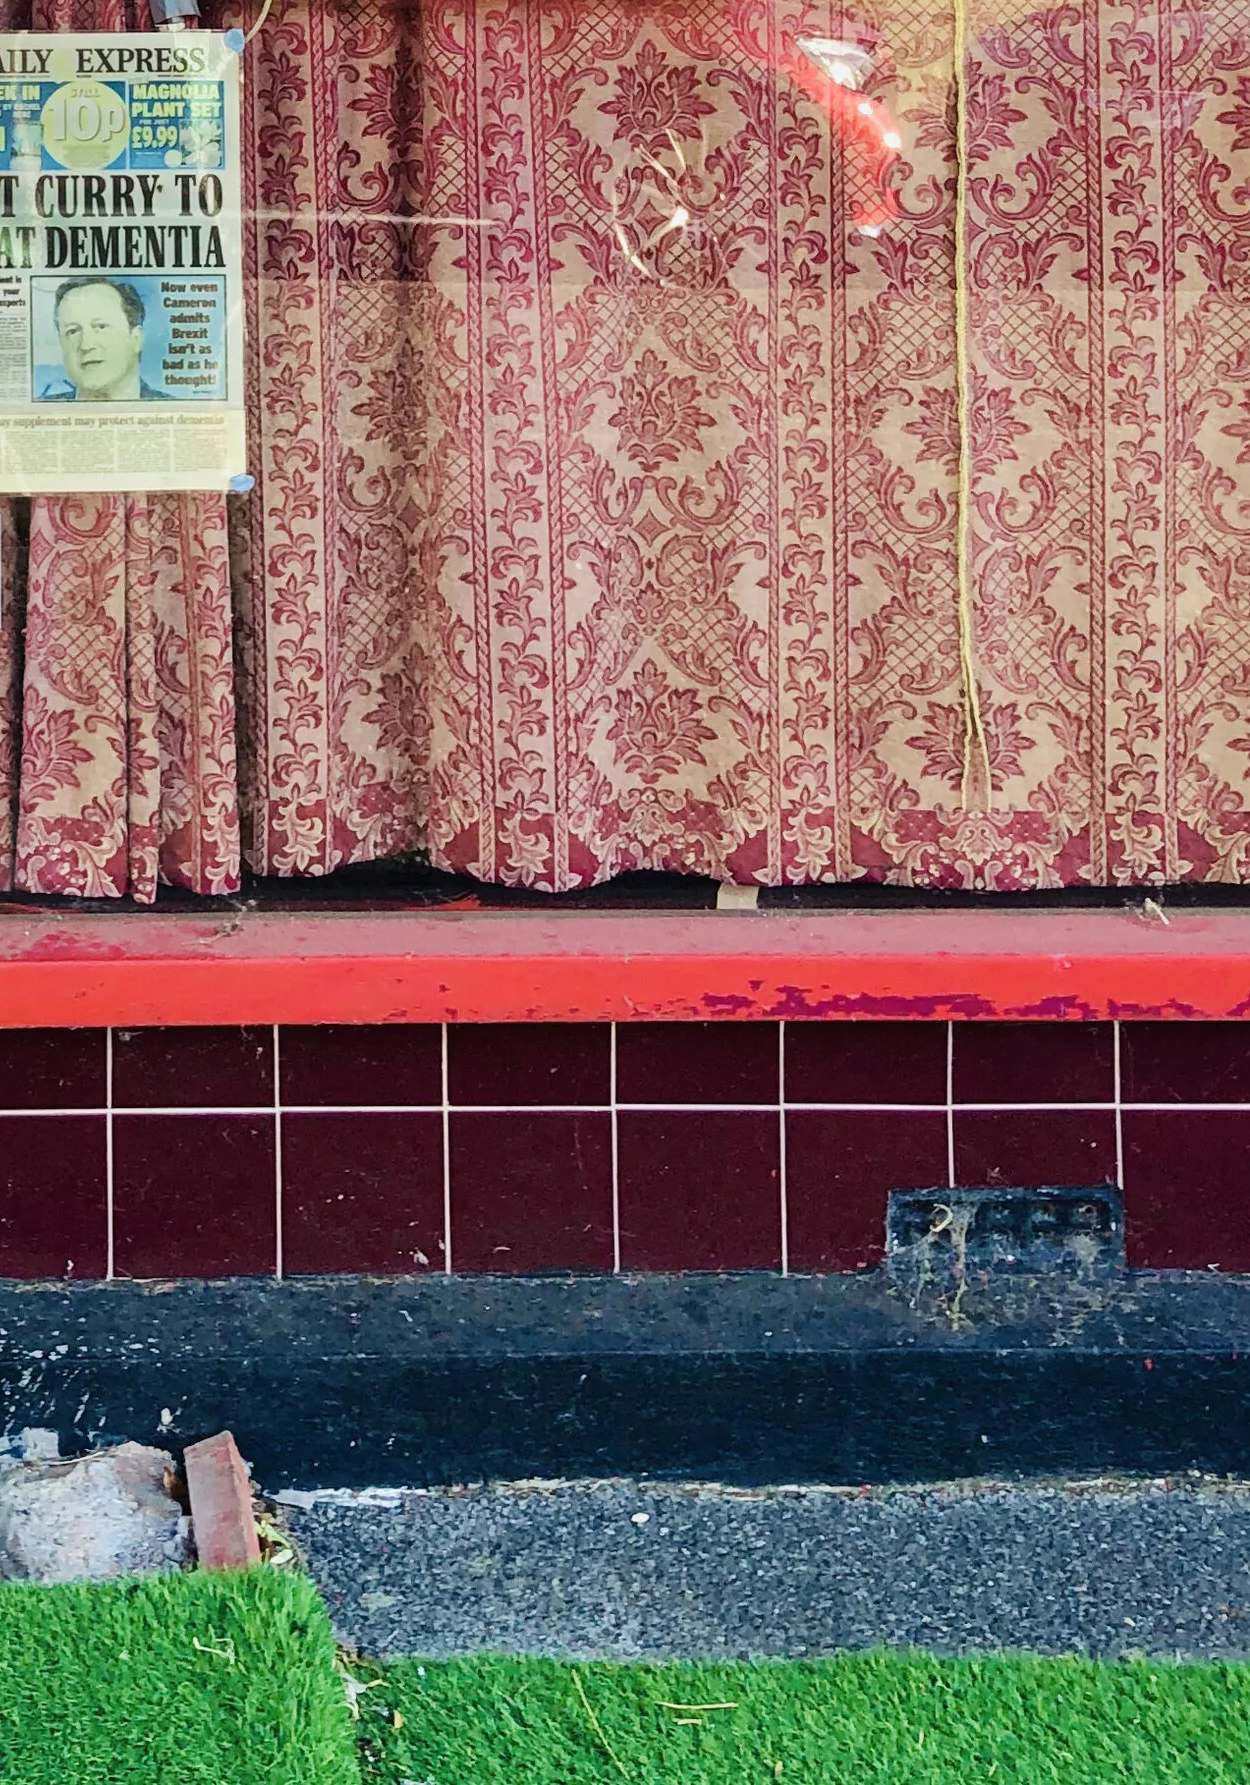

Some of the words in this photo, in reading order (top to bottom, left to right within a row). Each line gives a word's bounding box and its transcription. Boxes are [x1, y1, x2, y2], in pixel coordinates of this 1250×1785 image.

[76, 48, 205, 73] EXPRESS
[22, 85, 40, 100] IN
[133, 84, 220, 100] MAGNOLIA
[132, 102, 185, 117] PLANT
[190, 102, 222, 117] SET
[48, 98, 126, 143] 10p
[132, 126, 178, 149] £9.99
[35, 175, 160, 217] CURRY
[175, 174, 223, 217] TO
[45, 225, 227, 269] DEMENTIA
[161, 282, 186, 293] Now
[190, 283, 218, 292] even
[163, 297, 217, 308] Cameron
[170, 312, 211, 323] admits
[172, 328, 209, 339] Brexit
[198, 346, 213, 354] as
[162, 359, 184, 370] bad
[187, 360, 201, 370] as
[204, 359, 219, 369] he
[13, 416, 72, 428] supplement
[75, 417, 95, 428] may
[98, 415, 135, 428] protect
[137, 414, 174, 427] against
[176, 414, 224, 425] dementia
